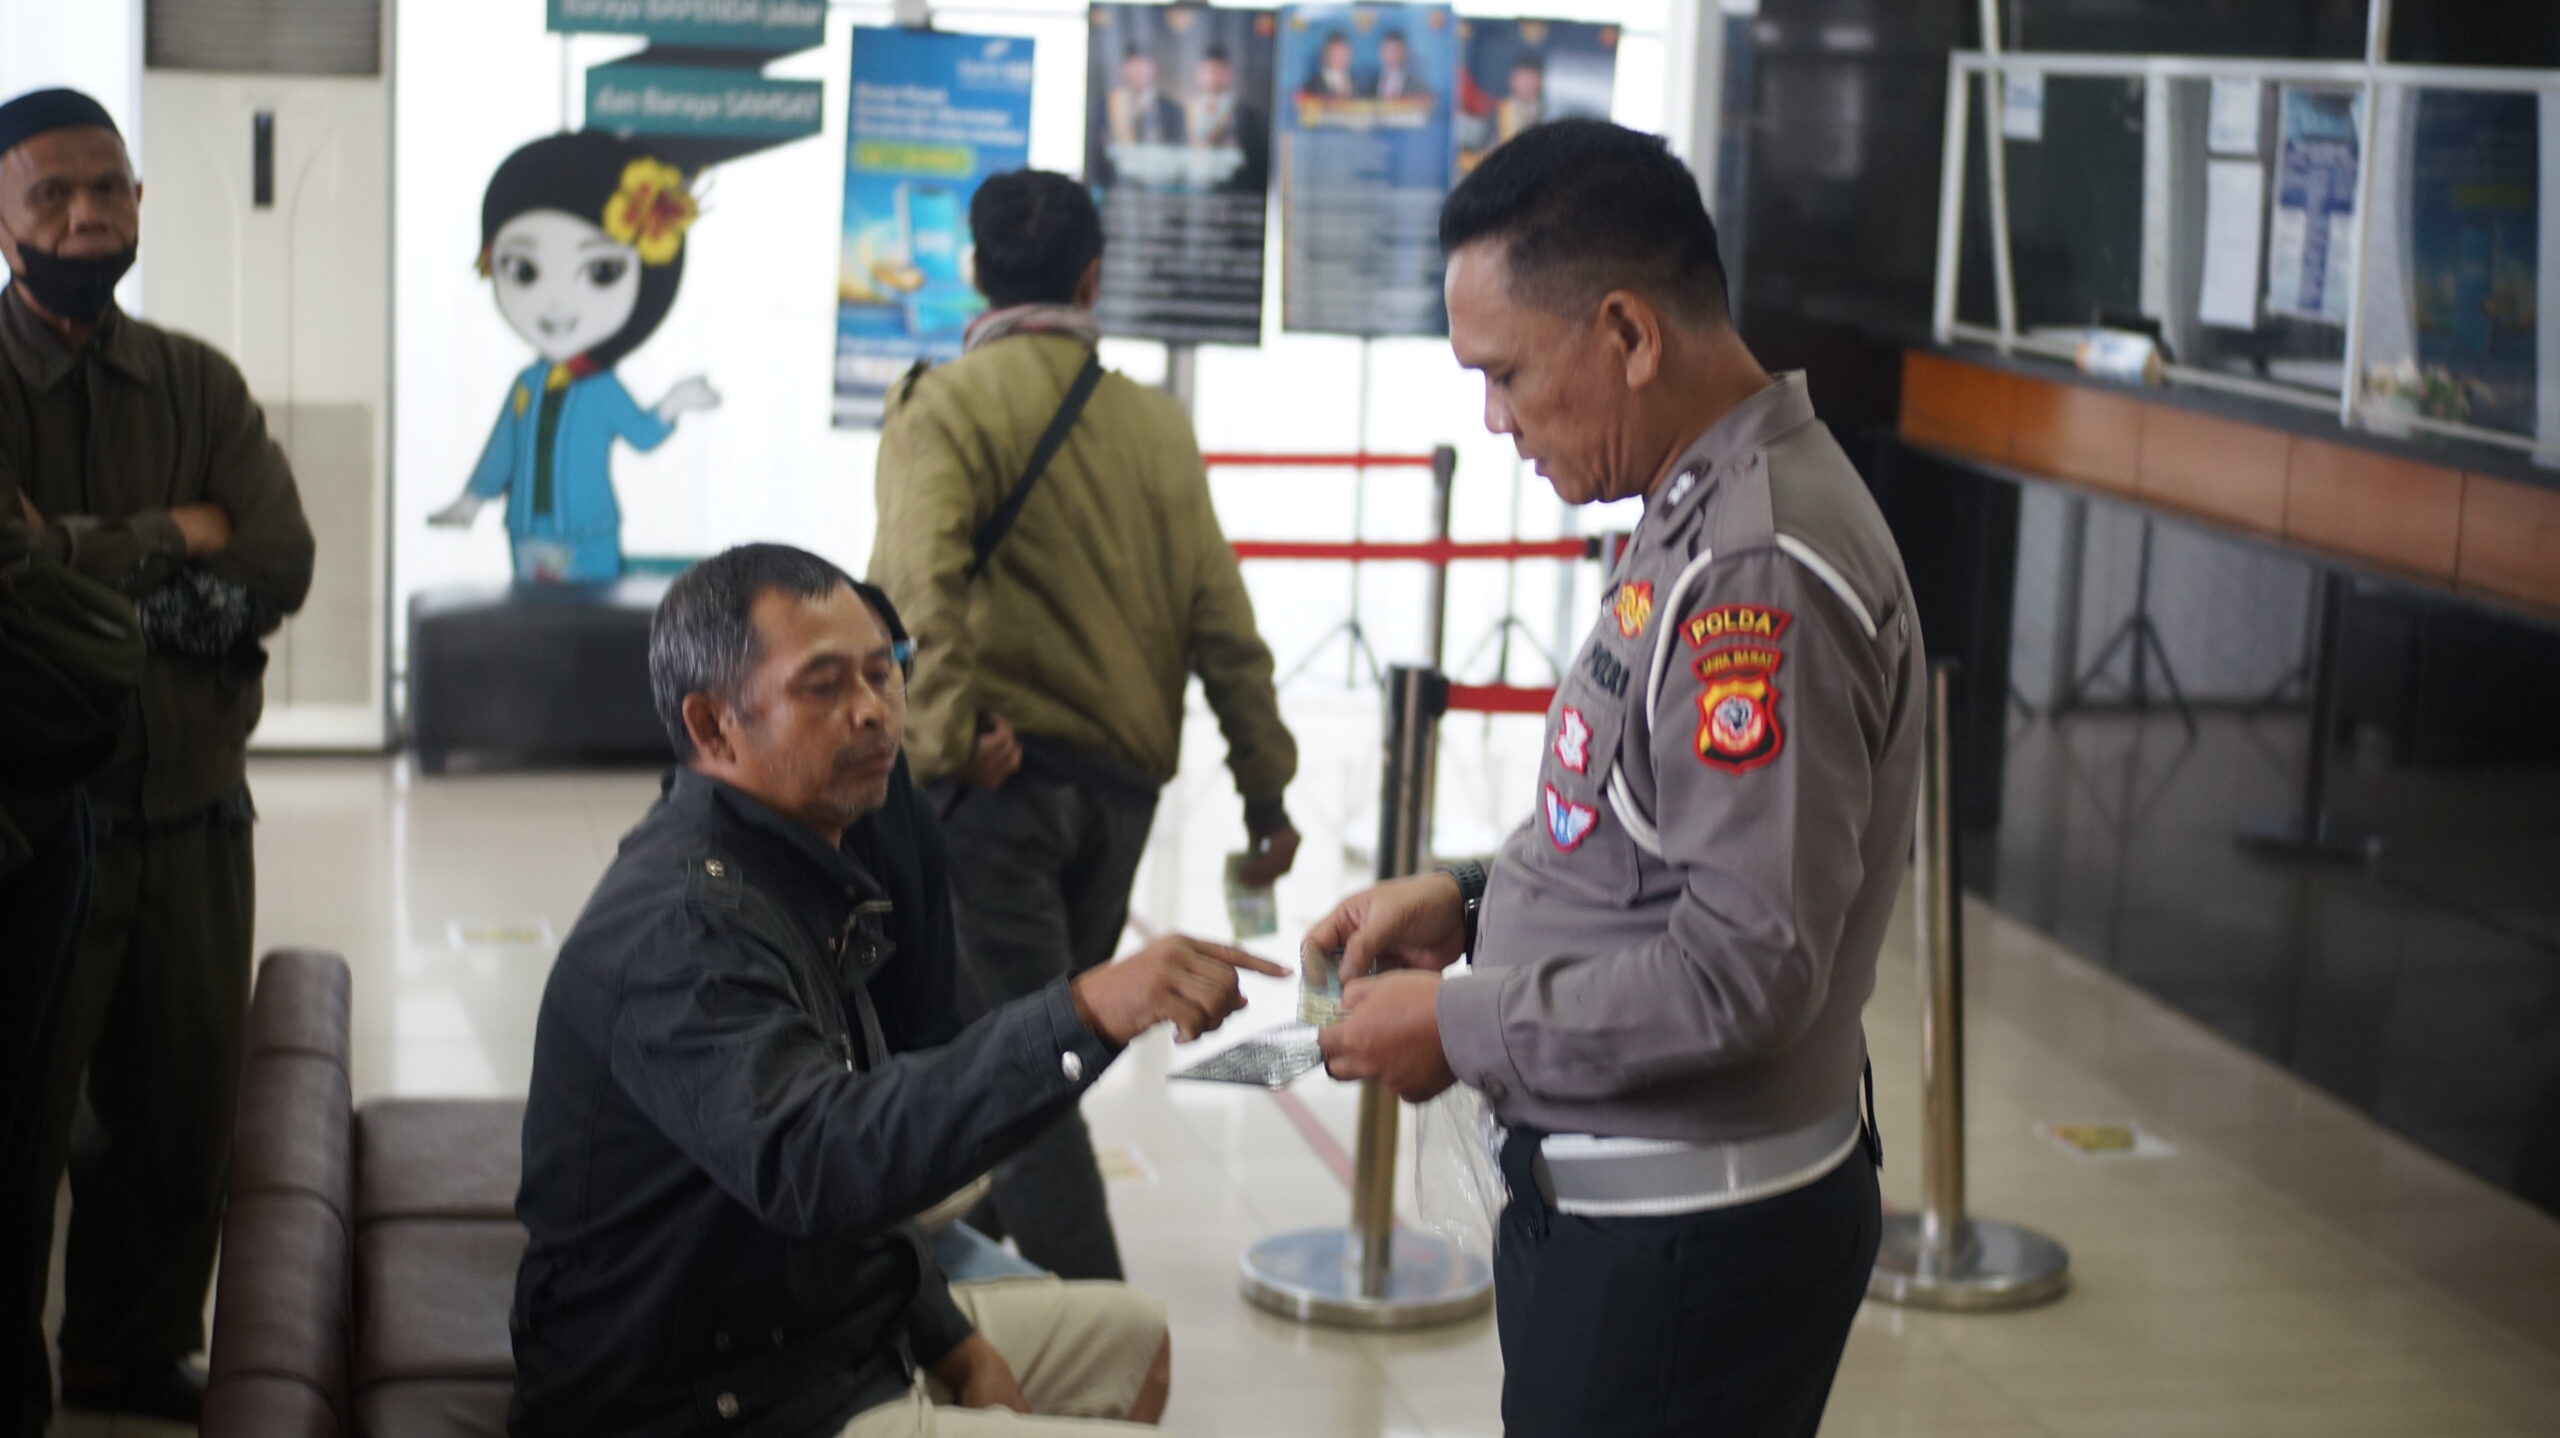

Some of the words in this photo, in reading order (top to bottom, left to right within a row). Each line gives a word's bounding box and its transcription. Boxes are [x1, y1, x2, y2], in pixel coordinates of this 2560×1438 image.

[1691, 608, 1771, 645] POLDA
[1702, 651, 1730, 677] JAWA
[1733, 649, 1773, 670] BARAT
